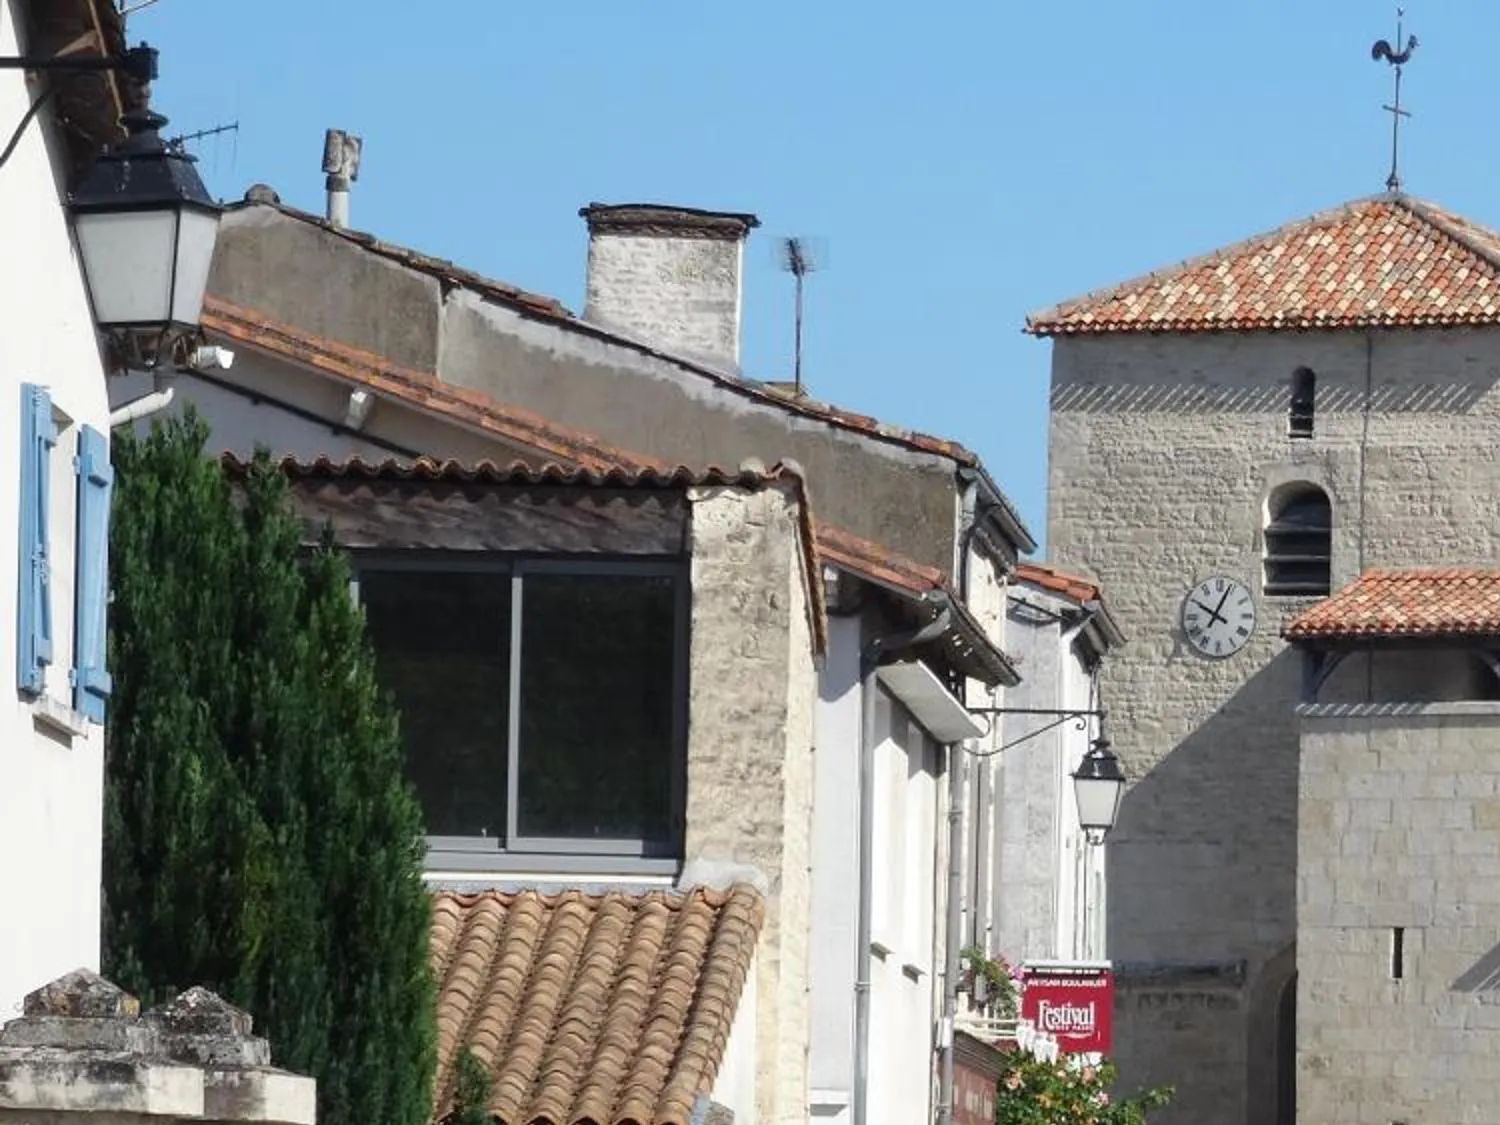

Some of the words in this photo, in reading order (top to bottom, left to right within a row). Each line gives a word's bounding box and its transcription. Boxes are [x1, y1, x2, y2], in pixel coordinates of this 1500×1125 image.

[1027, 979, 1060, 987] ARTISAN
[1062, 979, 1107, 987] BOULANGER
[1038, 1000, 1095, 1030] Festival
